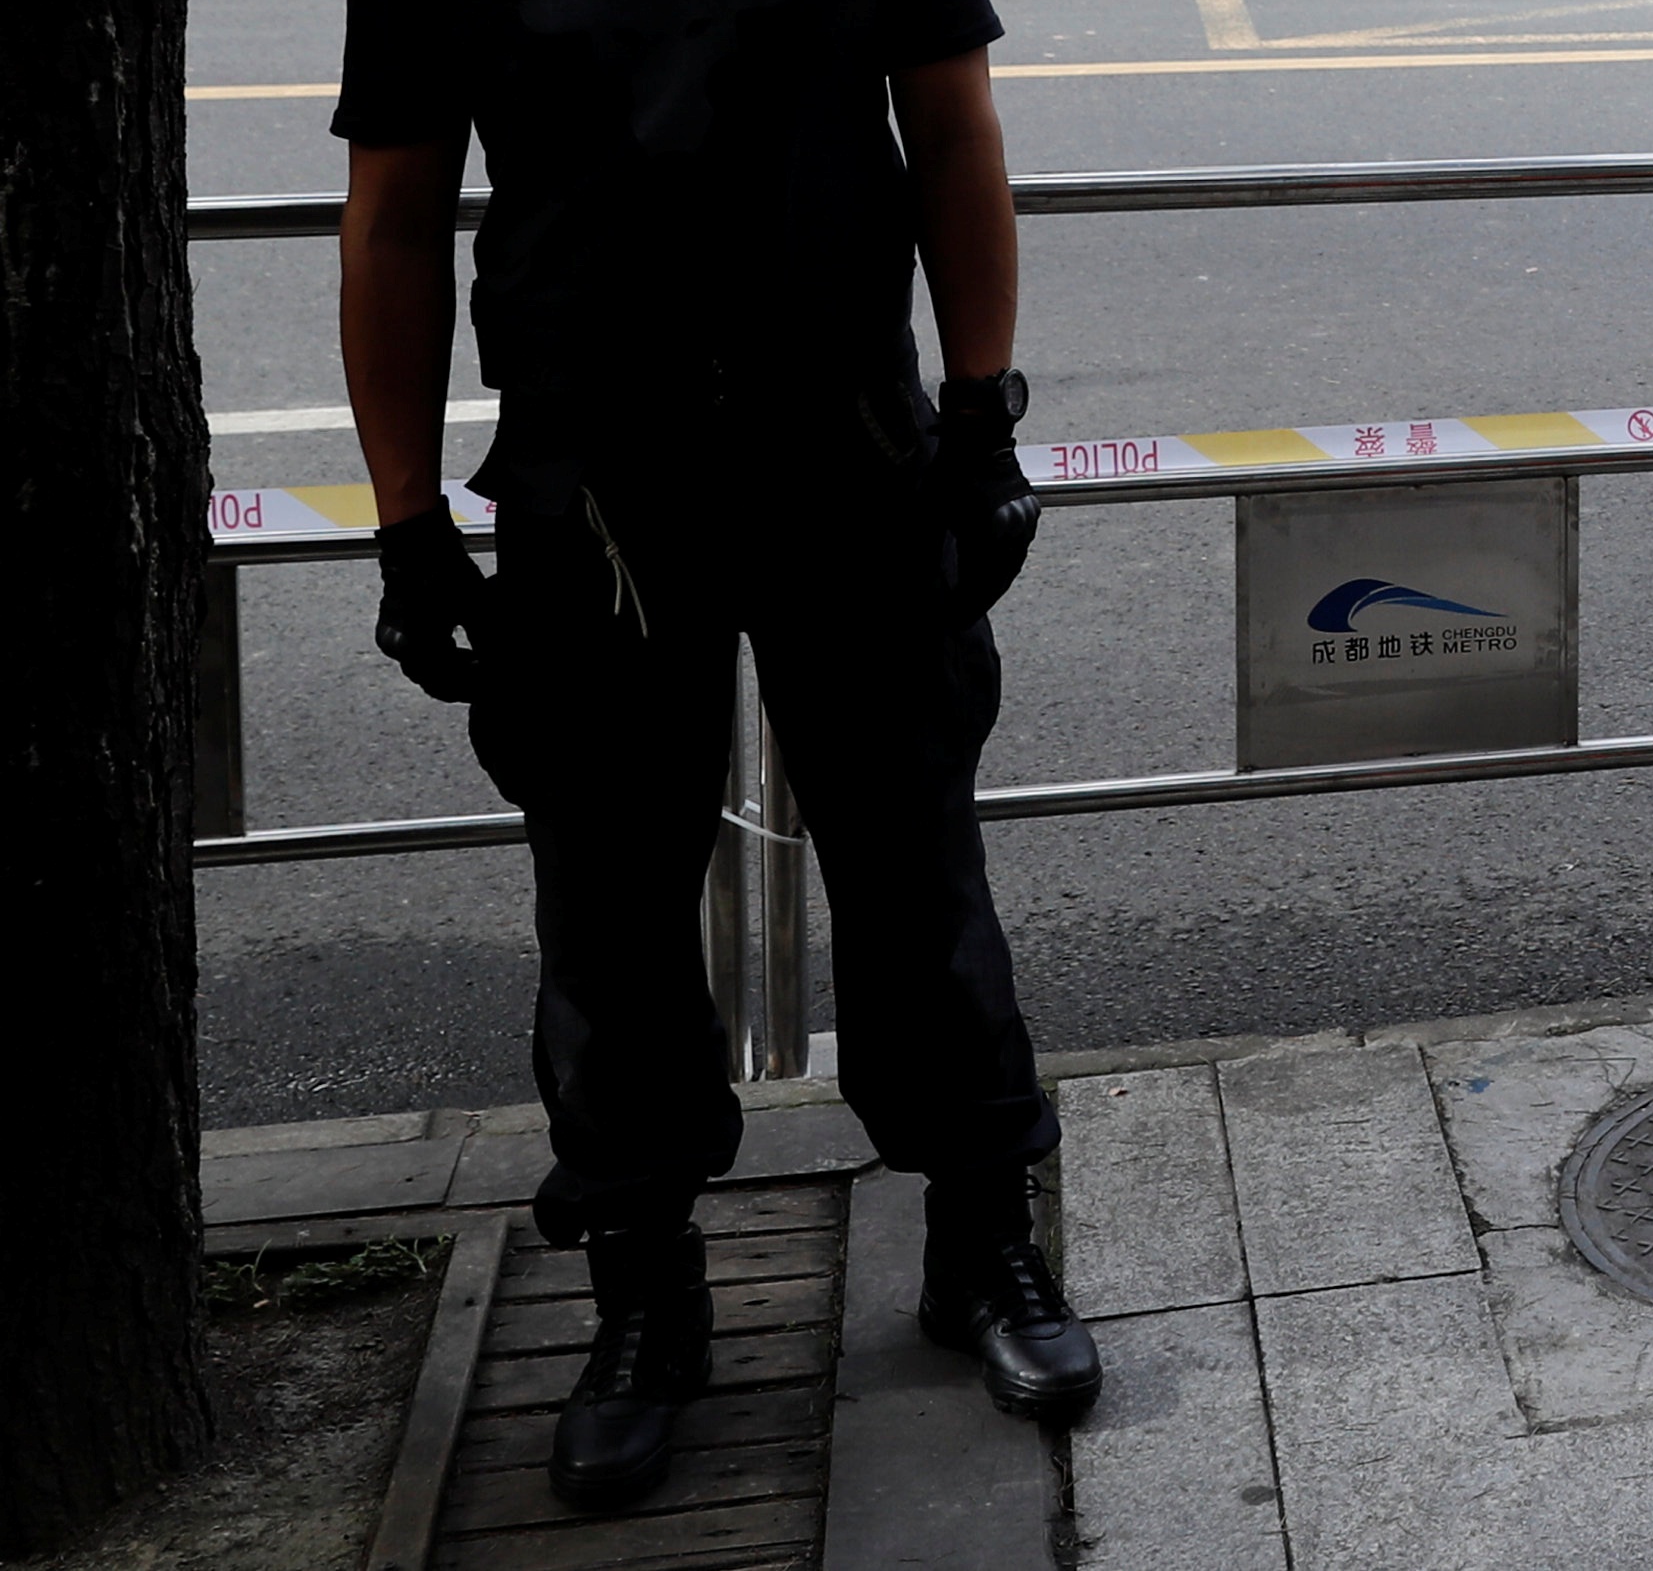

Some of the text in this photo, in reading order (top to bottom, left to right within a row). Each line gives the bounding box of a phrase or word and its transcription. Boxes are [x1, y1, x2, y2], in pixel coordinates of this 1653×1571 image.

[1354, 422, 1438, 458] 警察
[1051, 440, 1159, 480] POLICE
[210, 493, 263, 530] POL
[1312, 631, 1434, 665] 成都地铁
[1442, 626, 1517, 641] CHENGDU
[1443, 637, 1517, 654] METRO
